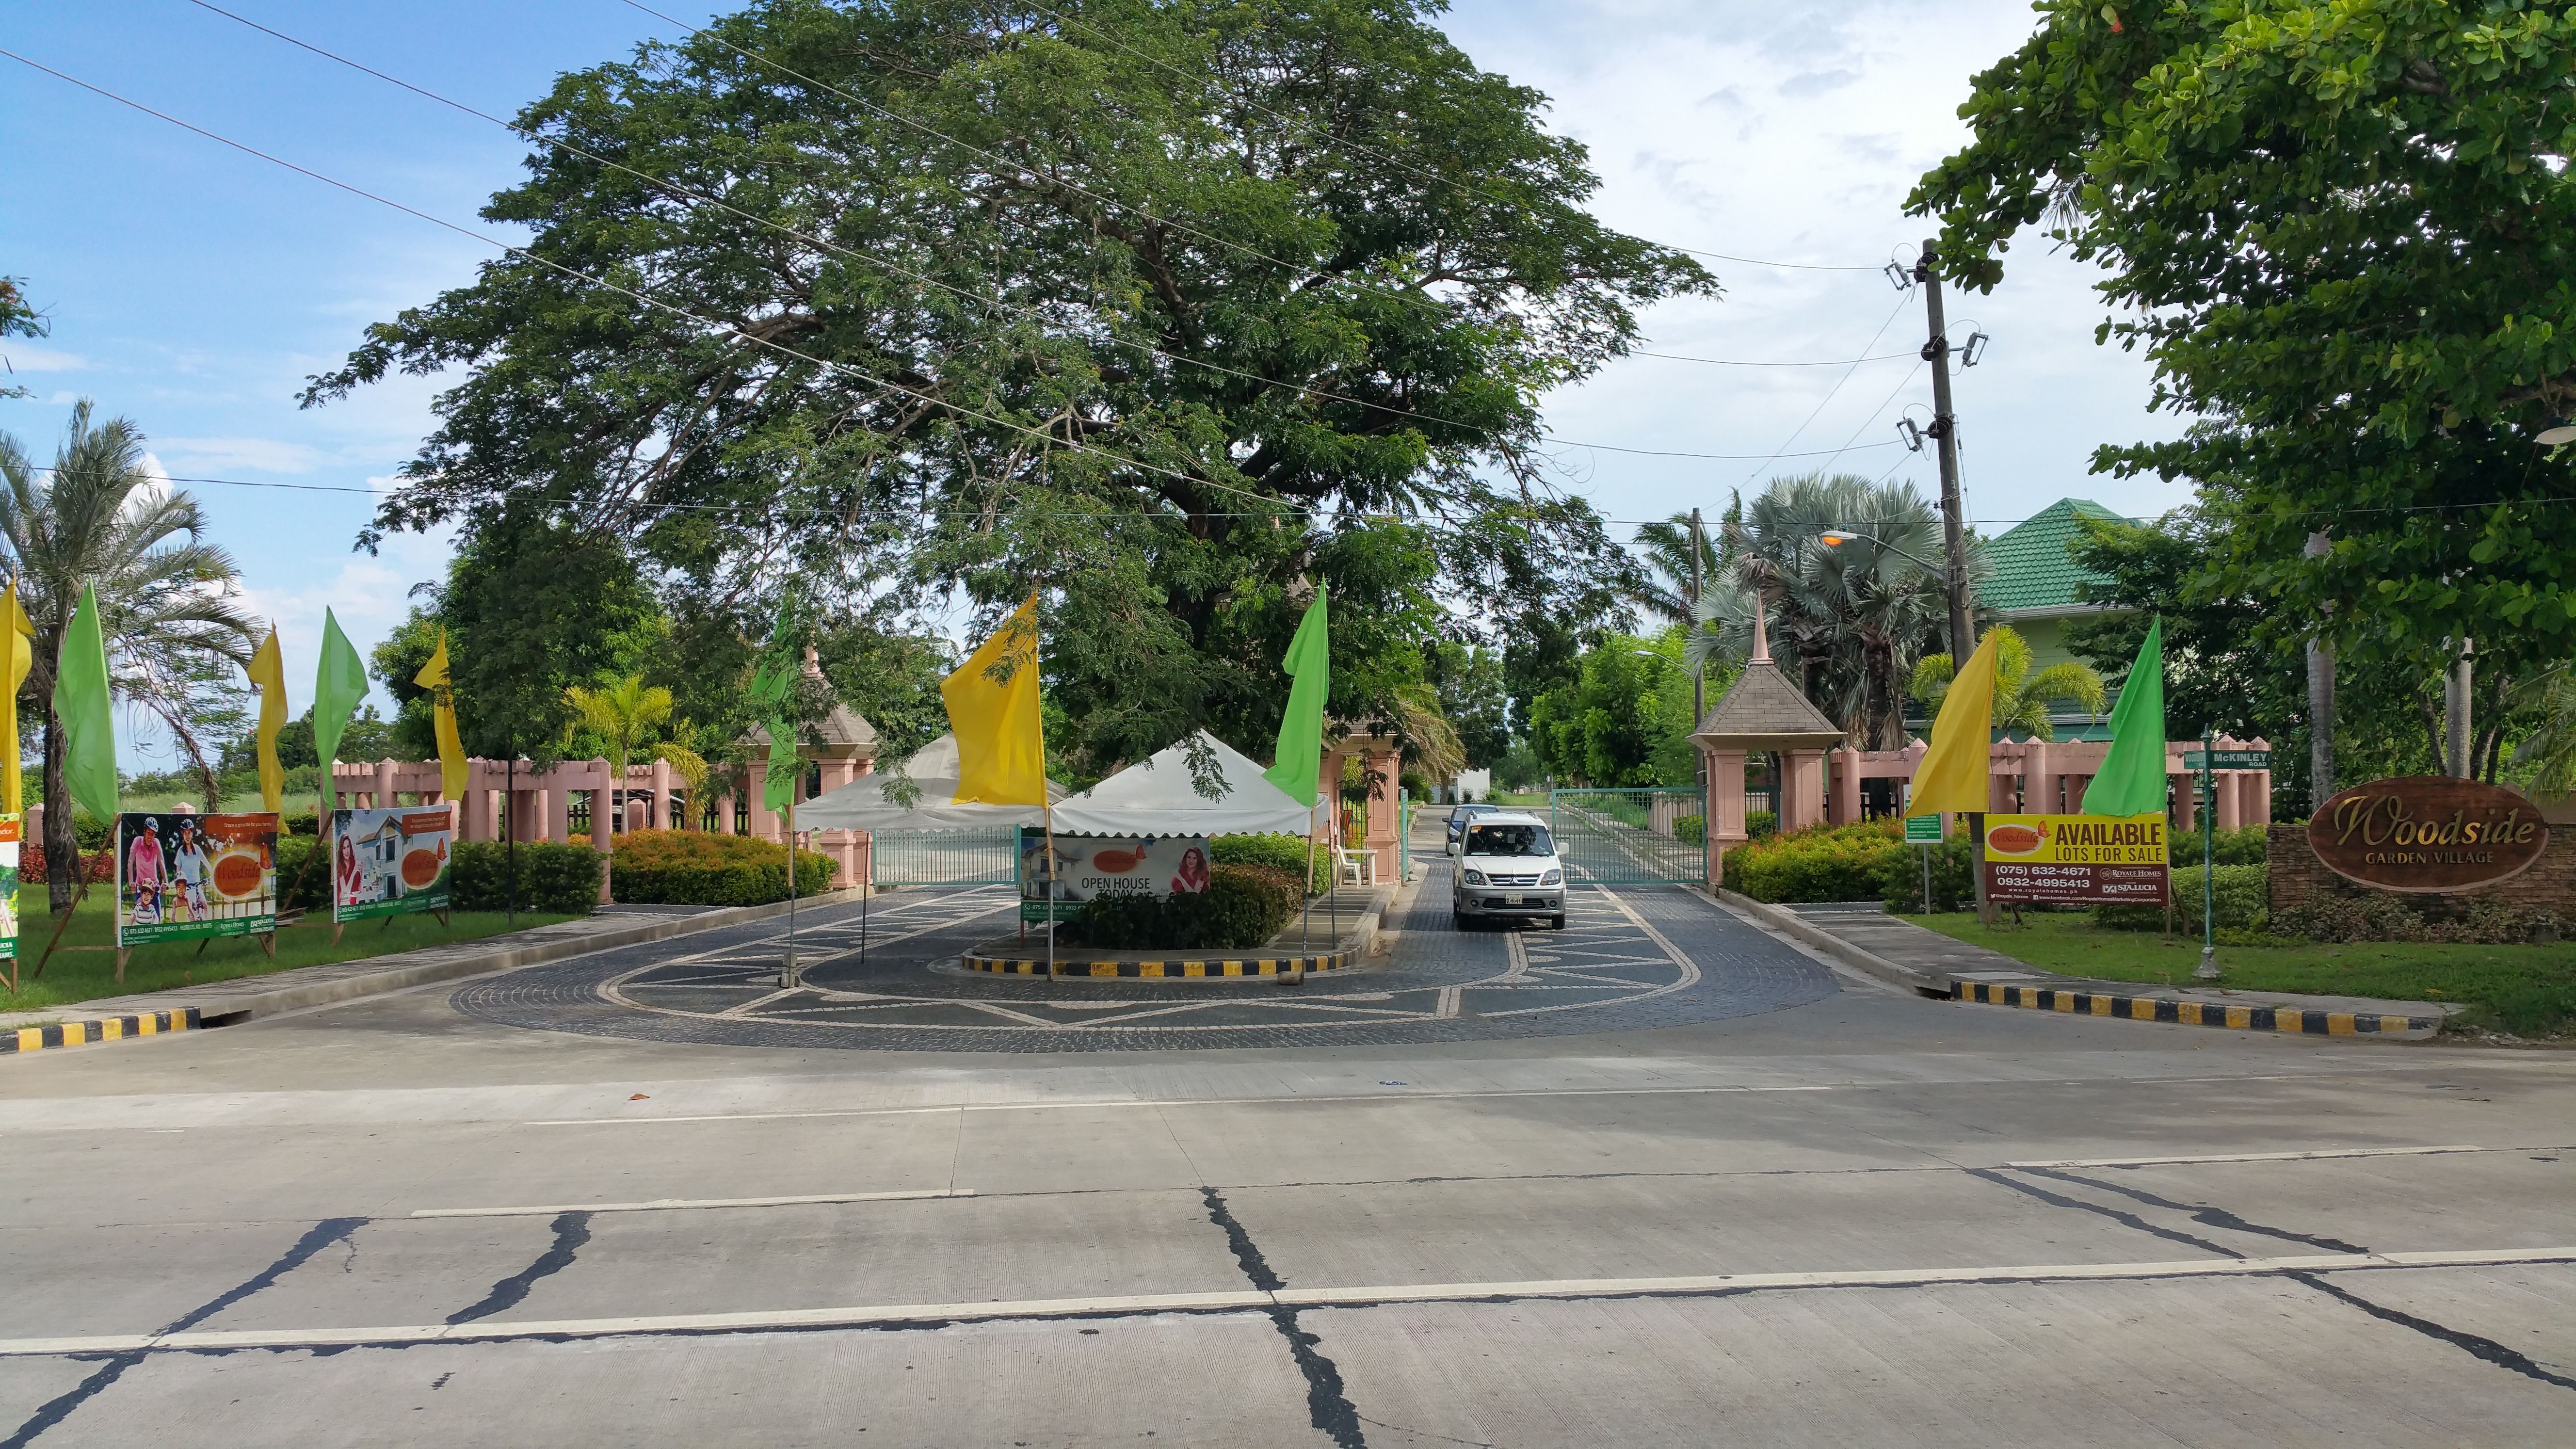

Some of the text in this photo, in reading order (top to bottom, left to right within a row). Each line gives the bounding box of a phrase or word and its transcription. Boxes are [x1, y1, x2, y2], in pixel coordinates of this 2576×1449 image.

[2214, 753, 2267, 762] McKINLEY
[2334, 795, 2536, 846] Woodside
[1990, 823, 2162, 846] Woodside AVAILABLE
[2056, 847, 2162, 862] LOTS FOR SALE
[2365, 851, 2494, 865] GARDEN VILLAGE
[216, 863, 260, 880] Woodside
[1996, 865, 2091, 876] (075) 632-4671
[2112, 869, 2137, 878] ROYALE
[1081, 877, 1150, 889] OPEN HOUSE
[1997, 877, 2090, 888] 0932-4995413
